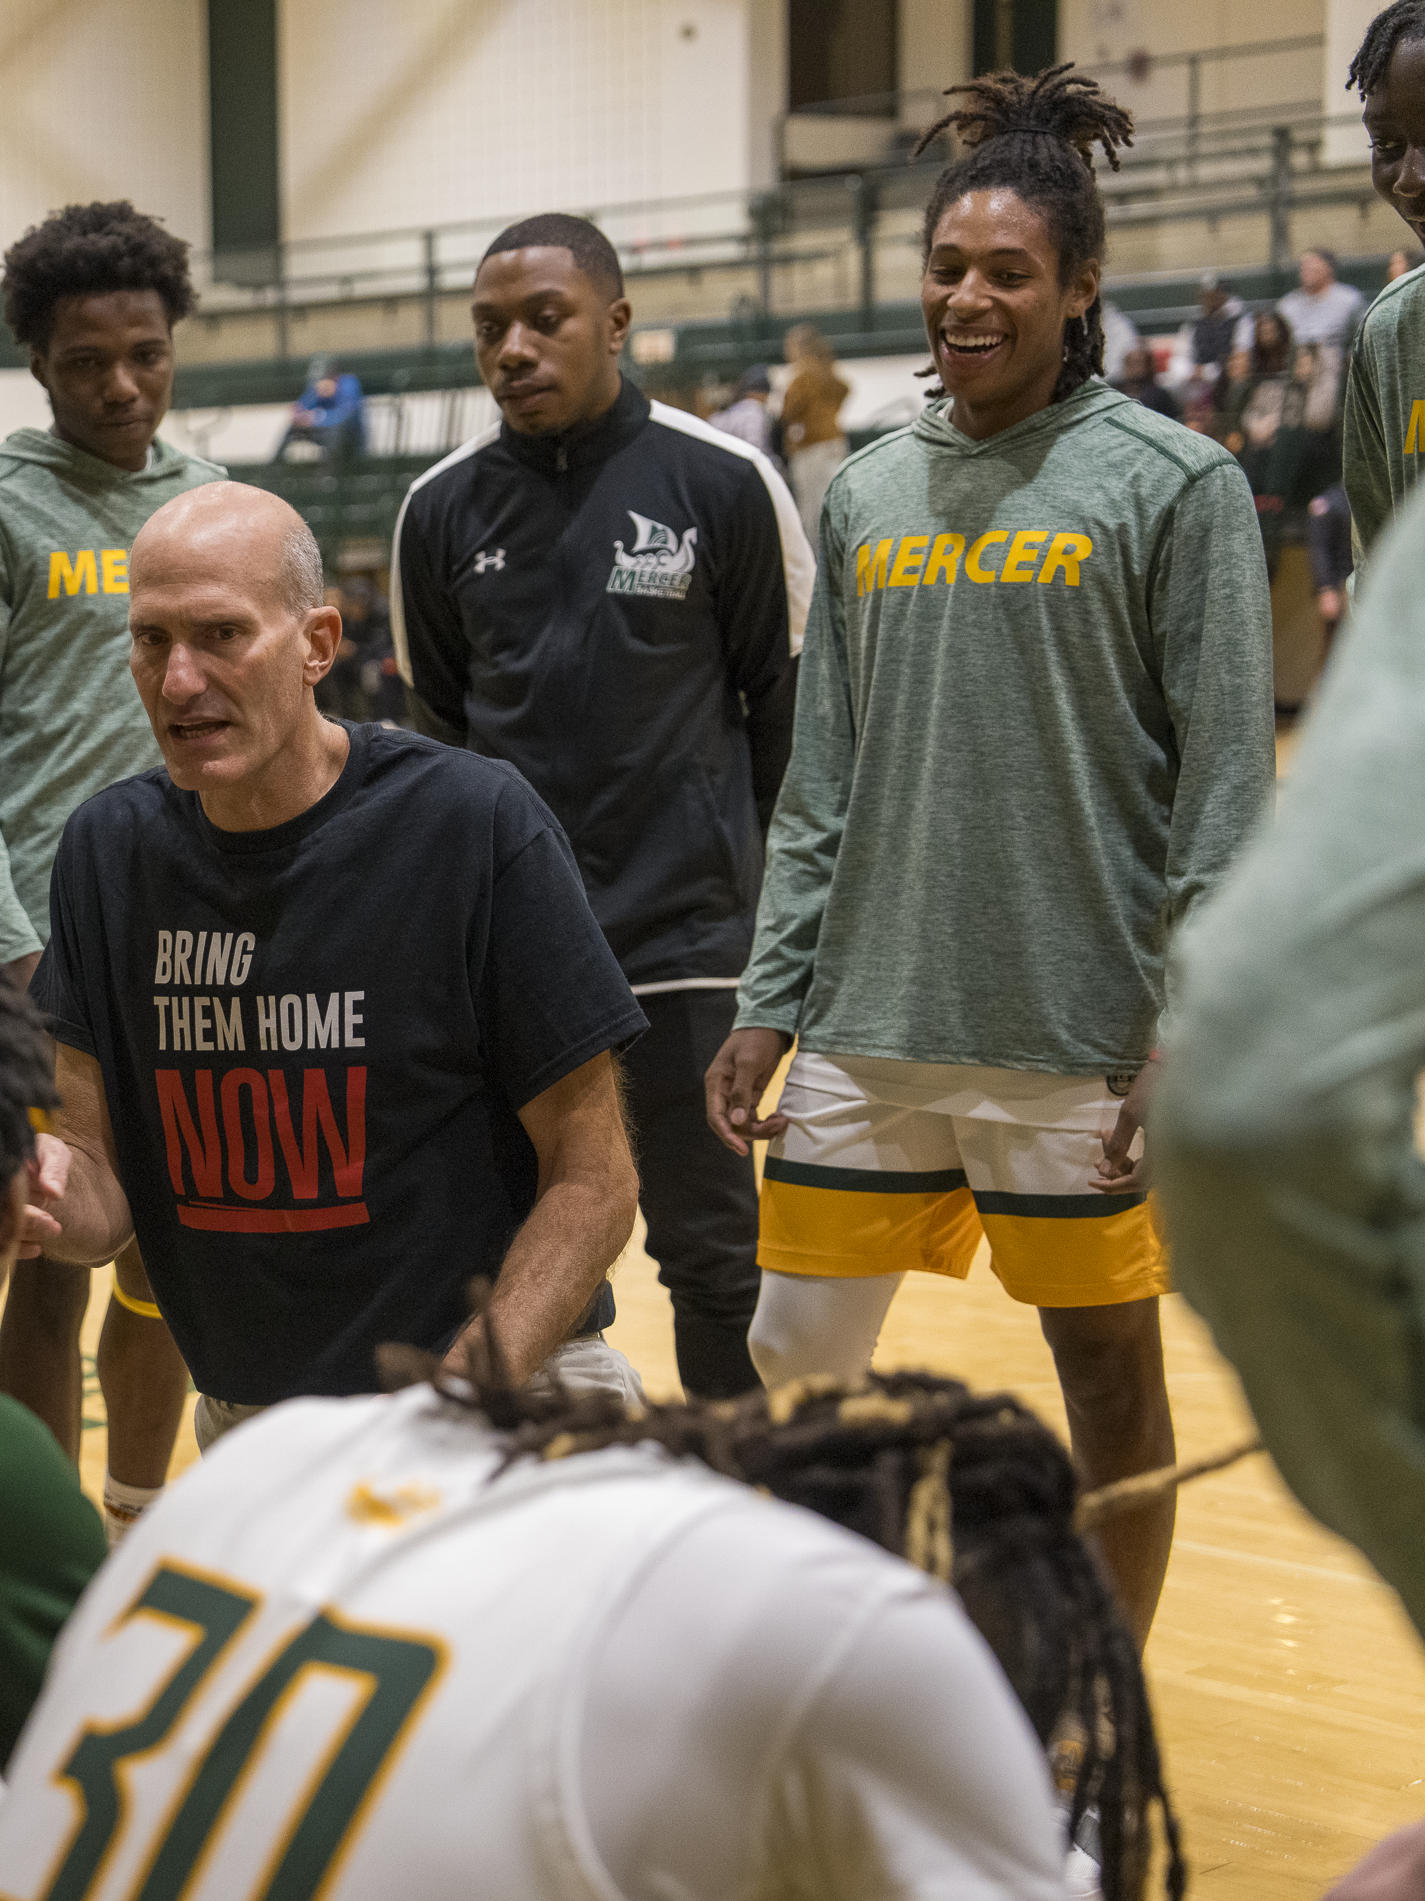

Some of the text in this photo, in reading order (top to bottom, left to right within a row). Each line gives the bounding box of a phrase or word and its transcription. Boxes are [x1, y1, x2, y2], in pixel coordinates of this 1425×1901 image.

[609, 568, 691, 593] MERCER
[856, 529, 1093, 597] MERCER
[154, 930, 256, 986] BRING
[153, 990, 366, 1051] THEM HOME
[154, 1066, 367, 1201] NOW
